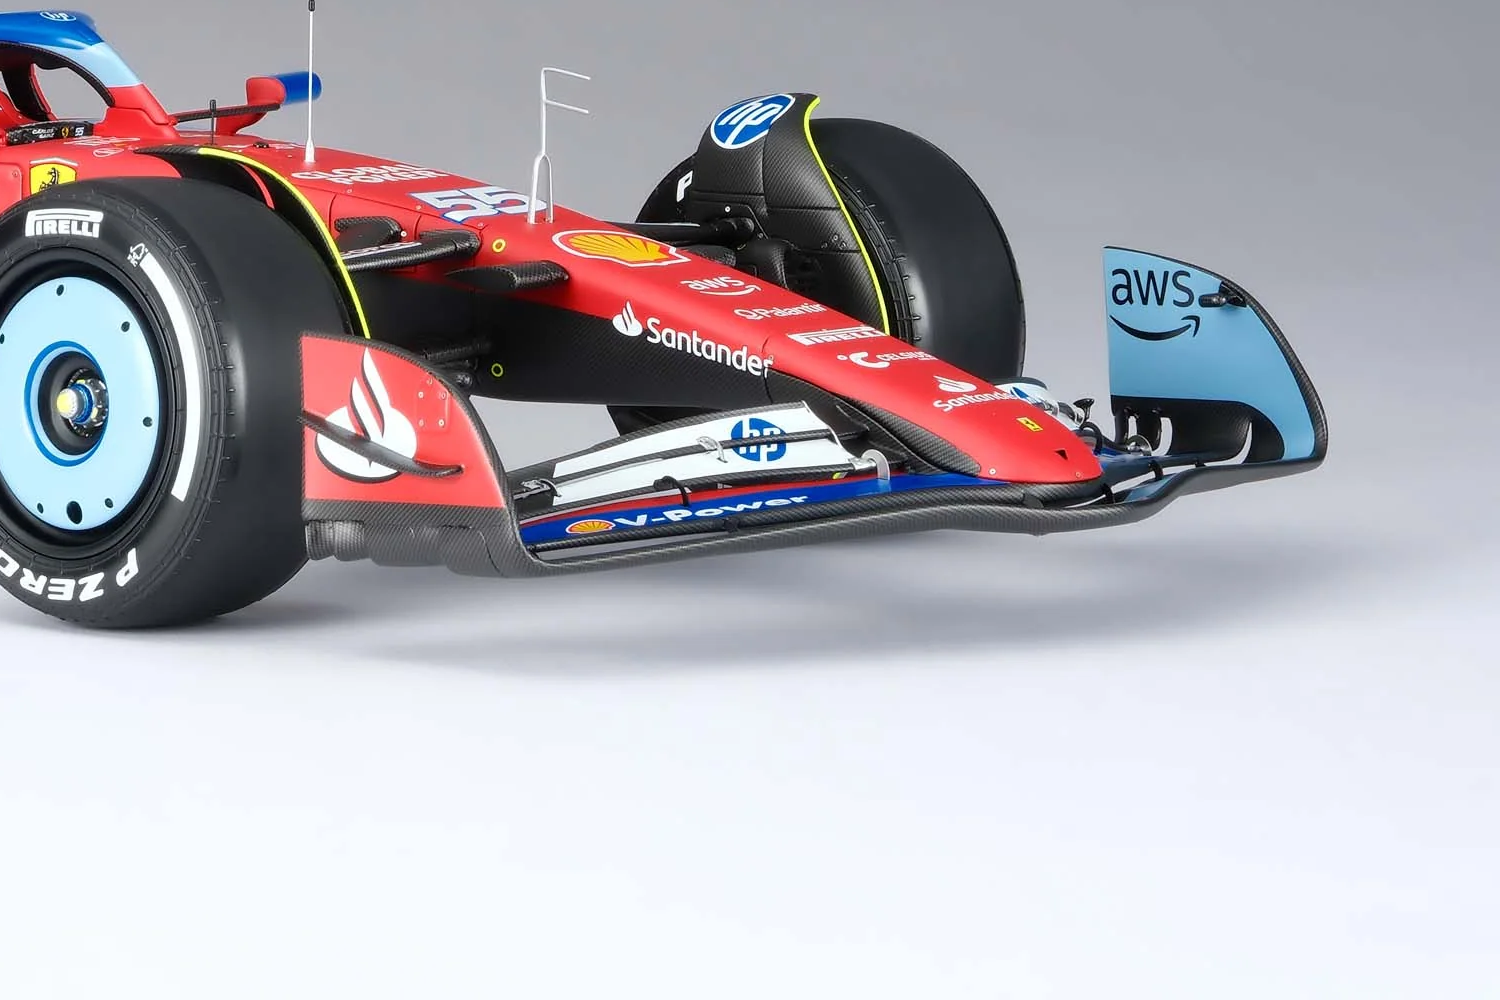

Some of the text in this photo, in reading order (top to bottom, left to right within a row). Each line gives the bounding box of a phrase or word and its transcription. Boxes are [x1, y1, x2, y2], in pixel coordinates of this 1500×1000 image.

[717, 98, 784, 146] hp
[291, 164, 431, 180] GLOBAL
[327, 170, 450, 185] POKER
[408, 186, 548, 224] 55
[25, 208, 104, 239] PIRELLI
[680, 276, 746, 291] aws
[1111, 268, 1195, 308] aws
[757, 302, 828, 319] Palantir
[647, 317, 774, 379] Santander
[786, 325, 889, 346] PIRELLI
[739, 417, 781, 463] hp
[614, 494, 809, 527] V-Power
[116, 547, 139, 588] P
